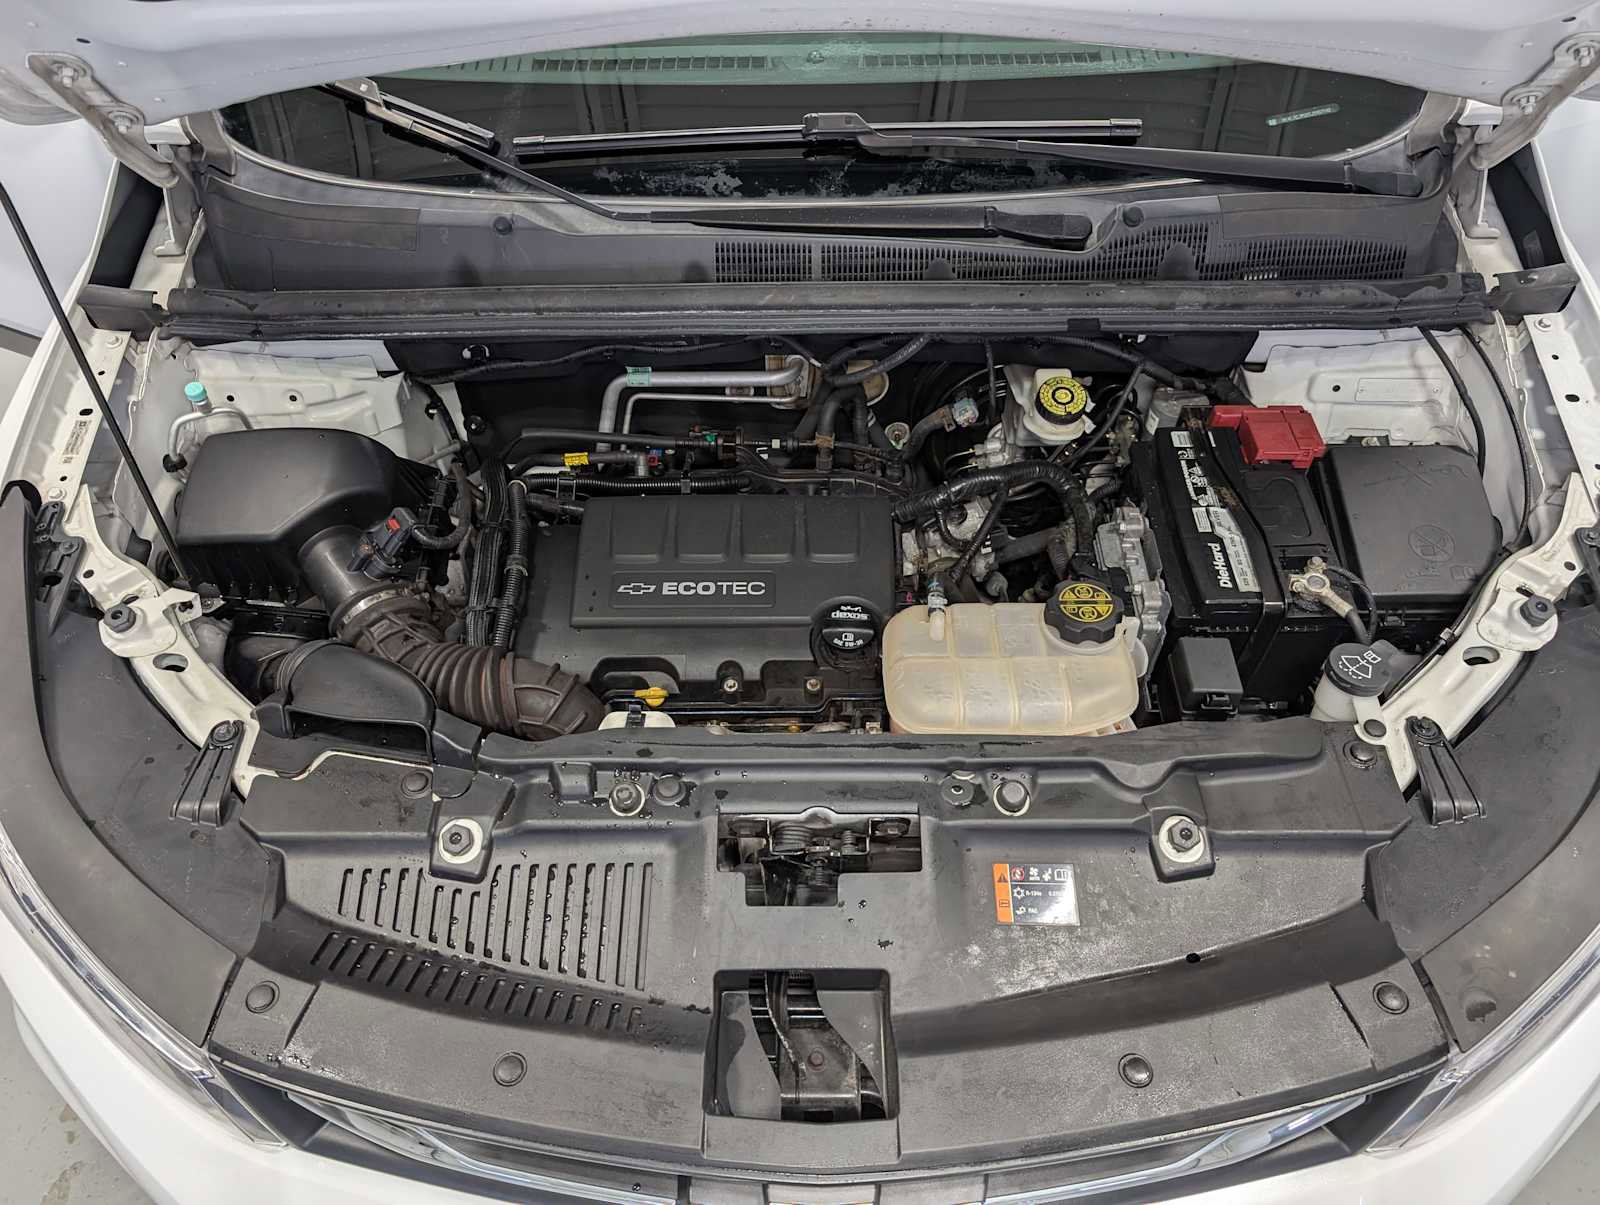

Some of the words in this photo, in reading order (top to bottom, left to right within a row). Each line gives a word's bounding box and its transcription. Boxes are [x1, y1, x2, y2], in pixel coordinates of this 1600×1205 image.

[1207, 543, 1233, 588] DieHard
[662, 581, 766, 595] ECOTEC
[831, 610, 871, 620] dexos
